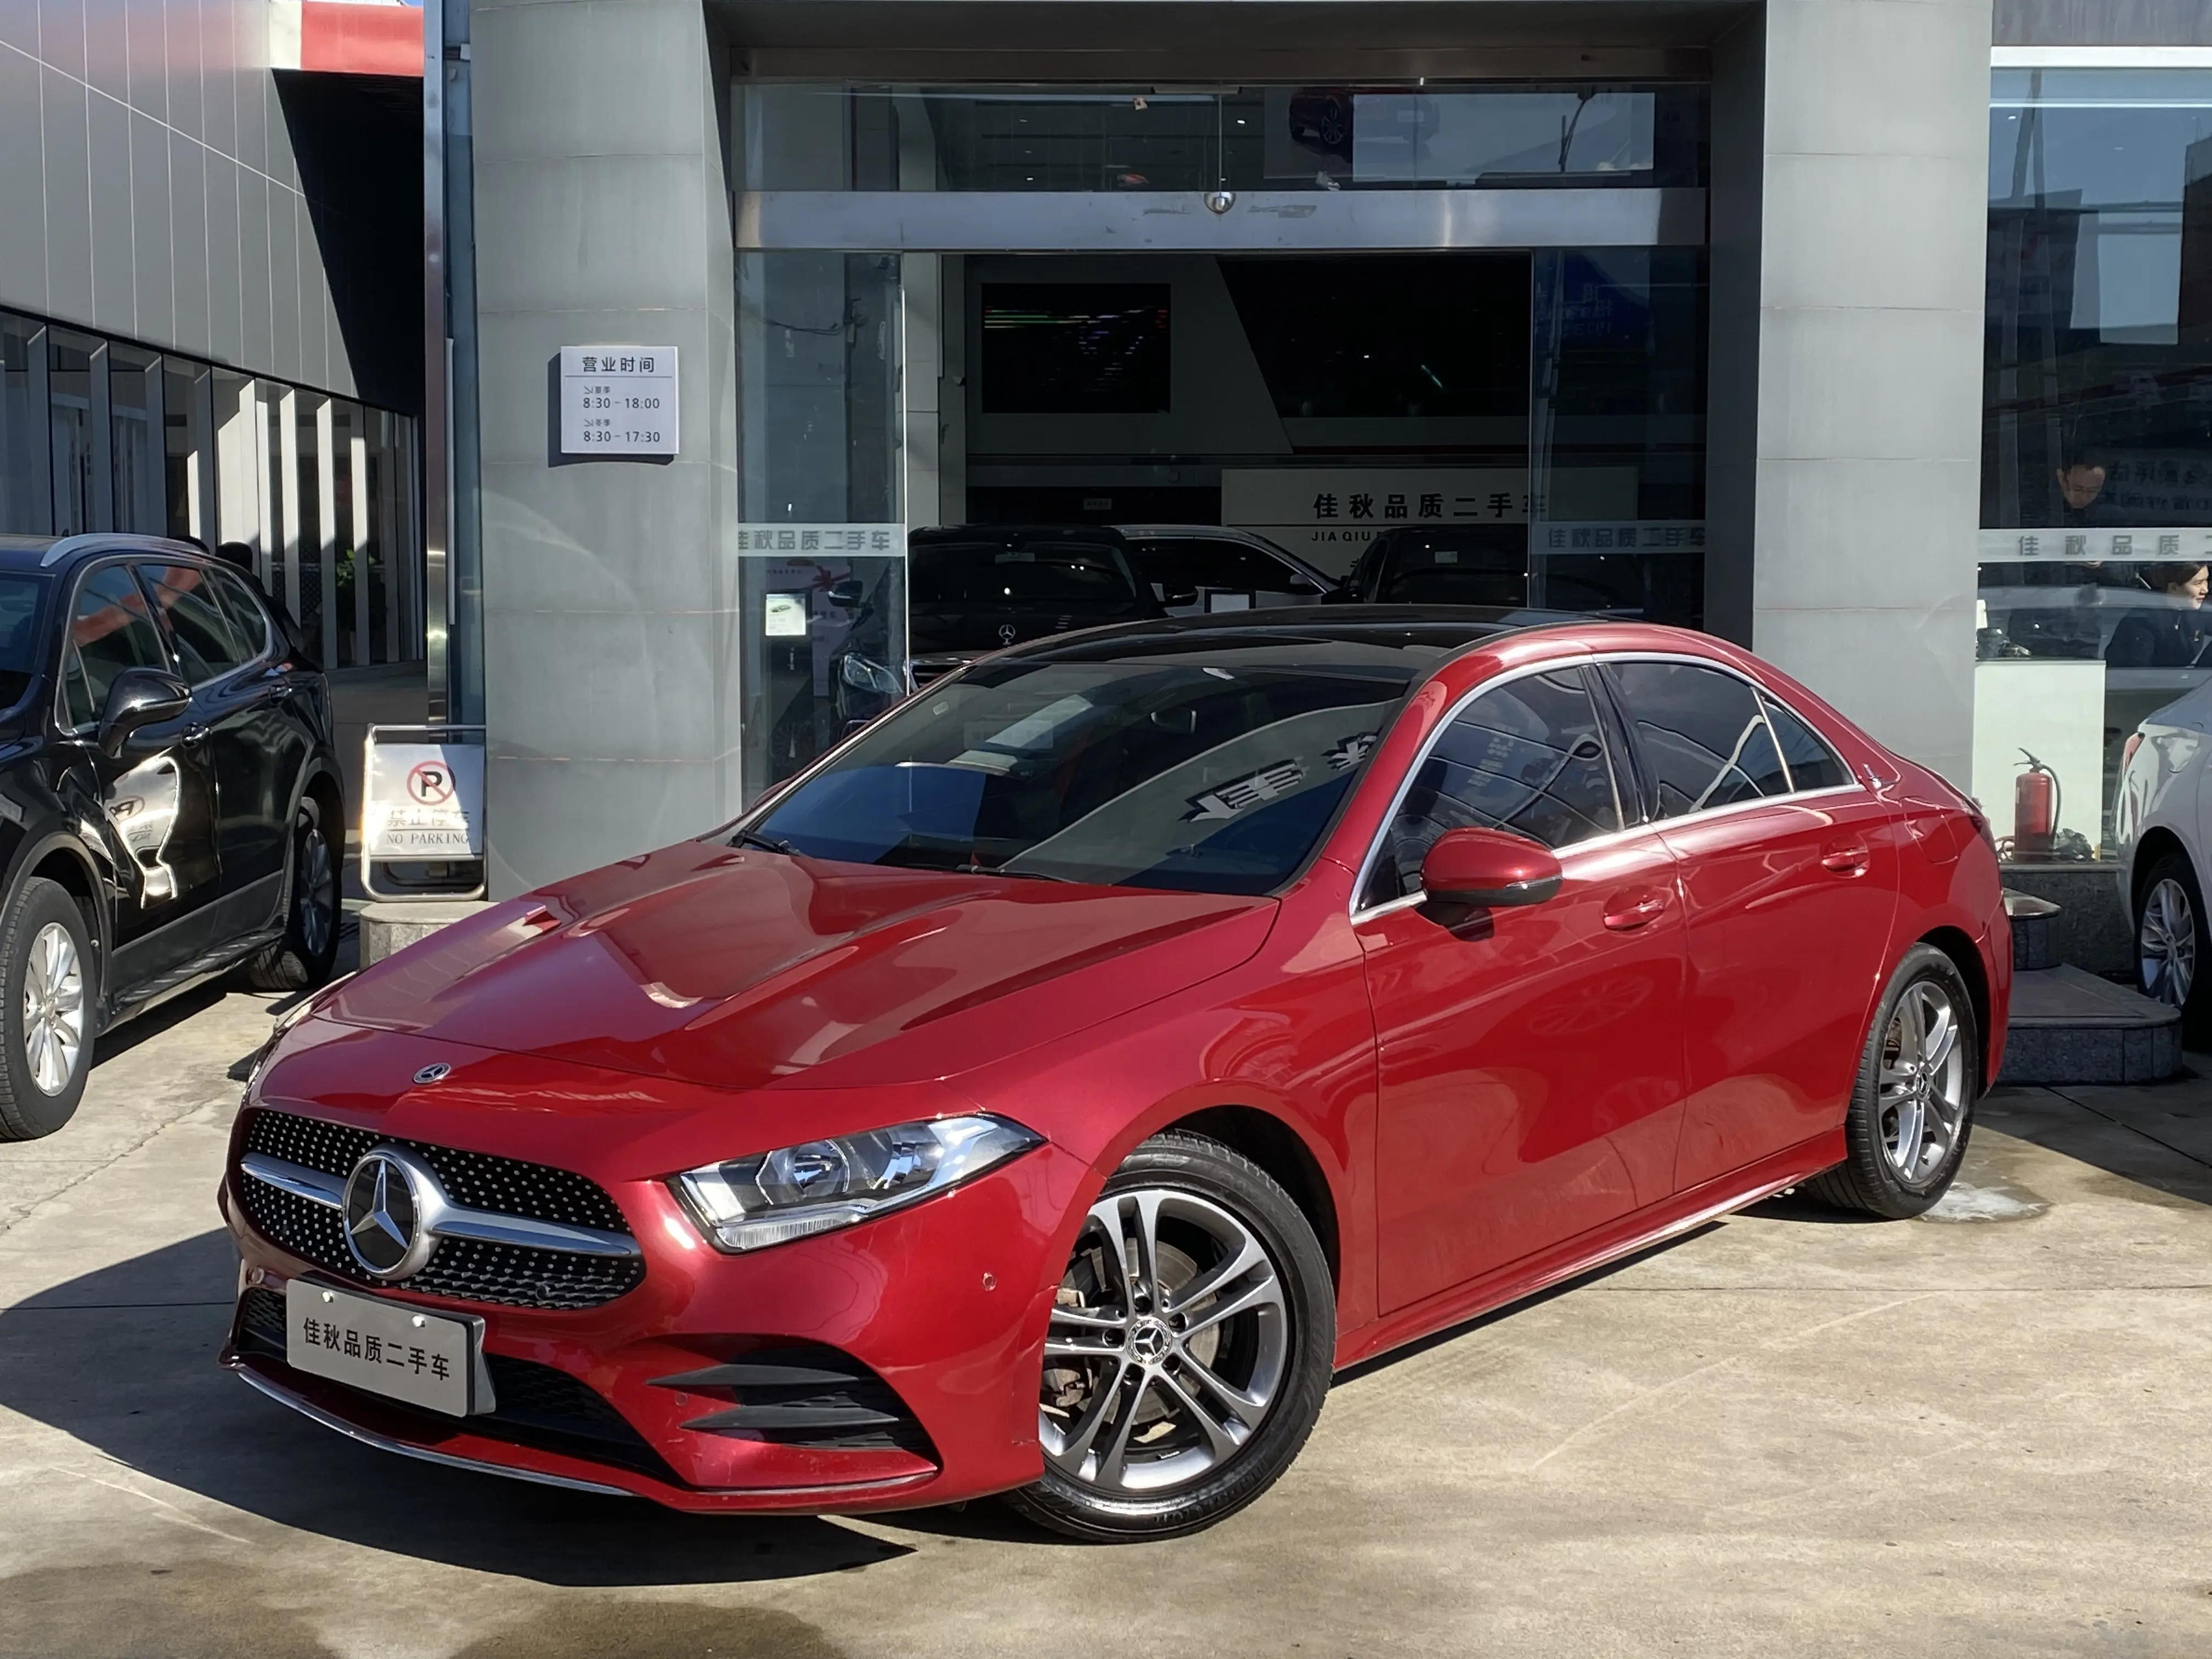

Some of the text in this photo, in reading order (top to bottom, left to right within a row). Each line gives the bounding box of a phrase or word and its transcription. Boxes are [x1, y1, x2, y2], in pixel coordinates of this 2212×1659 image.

[582, 357, 654, 373] 营业时间
[1313, 493, 1546, 519] 佳秋品质二手车
[387, 834, 403, 844] NO
[303, 1317, 449, 1381] 佳秋品质二手车
